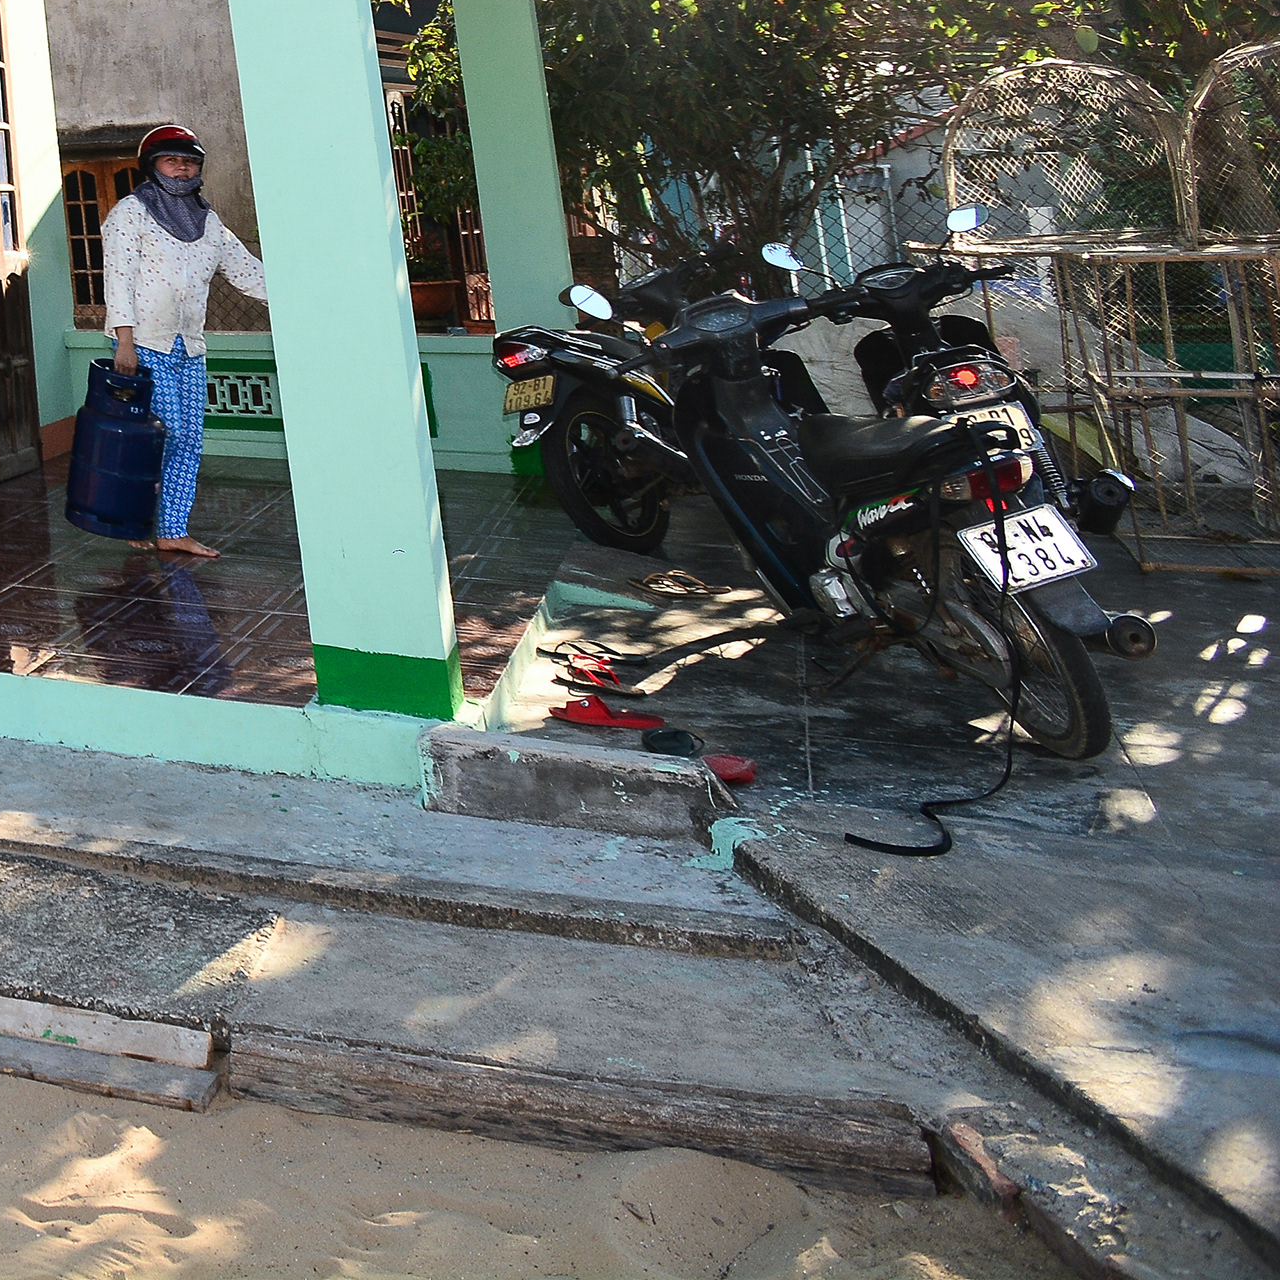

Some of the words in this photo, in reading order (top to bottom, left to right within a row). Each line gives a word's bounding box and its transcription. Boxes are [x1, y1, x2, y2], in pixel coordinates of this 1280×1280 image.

[513, 377, 547, 396] 92-B1
[734, 473, 769, 482] HONDA
[980, 516, 1054, 554] 9-N4
